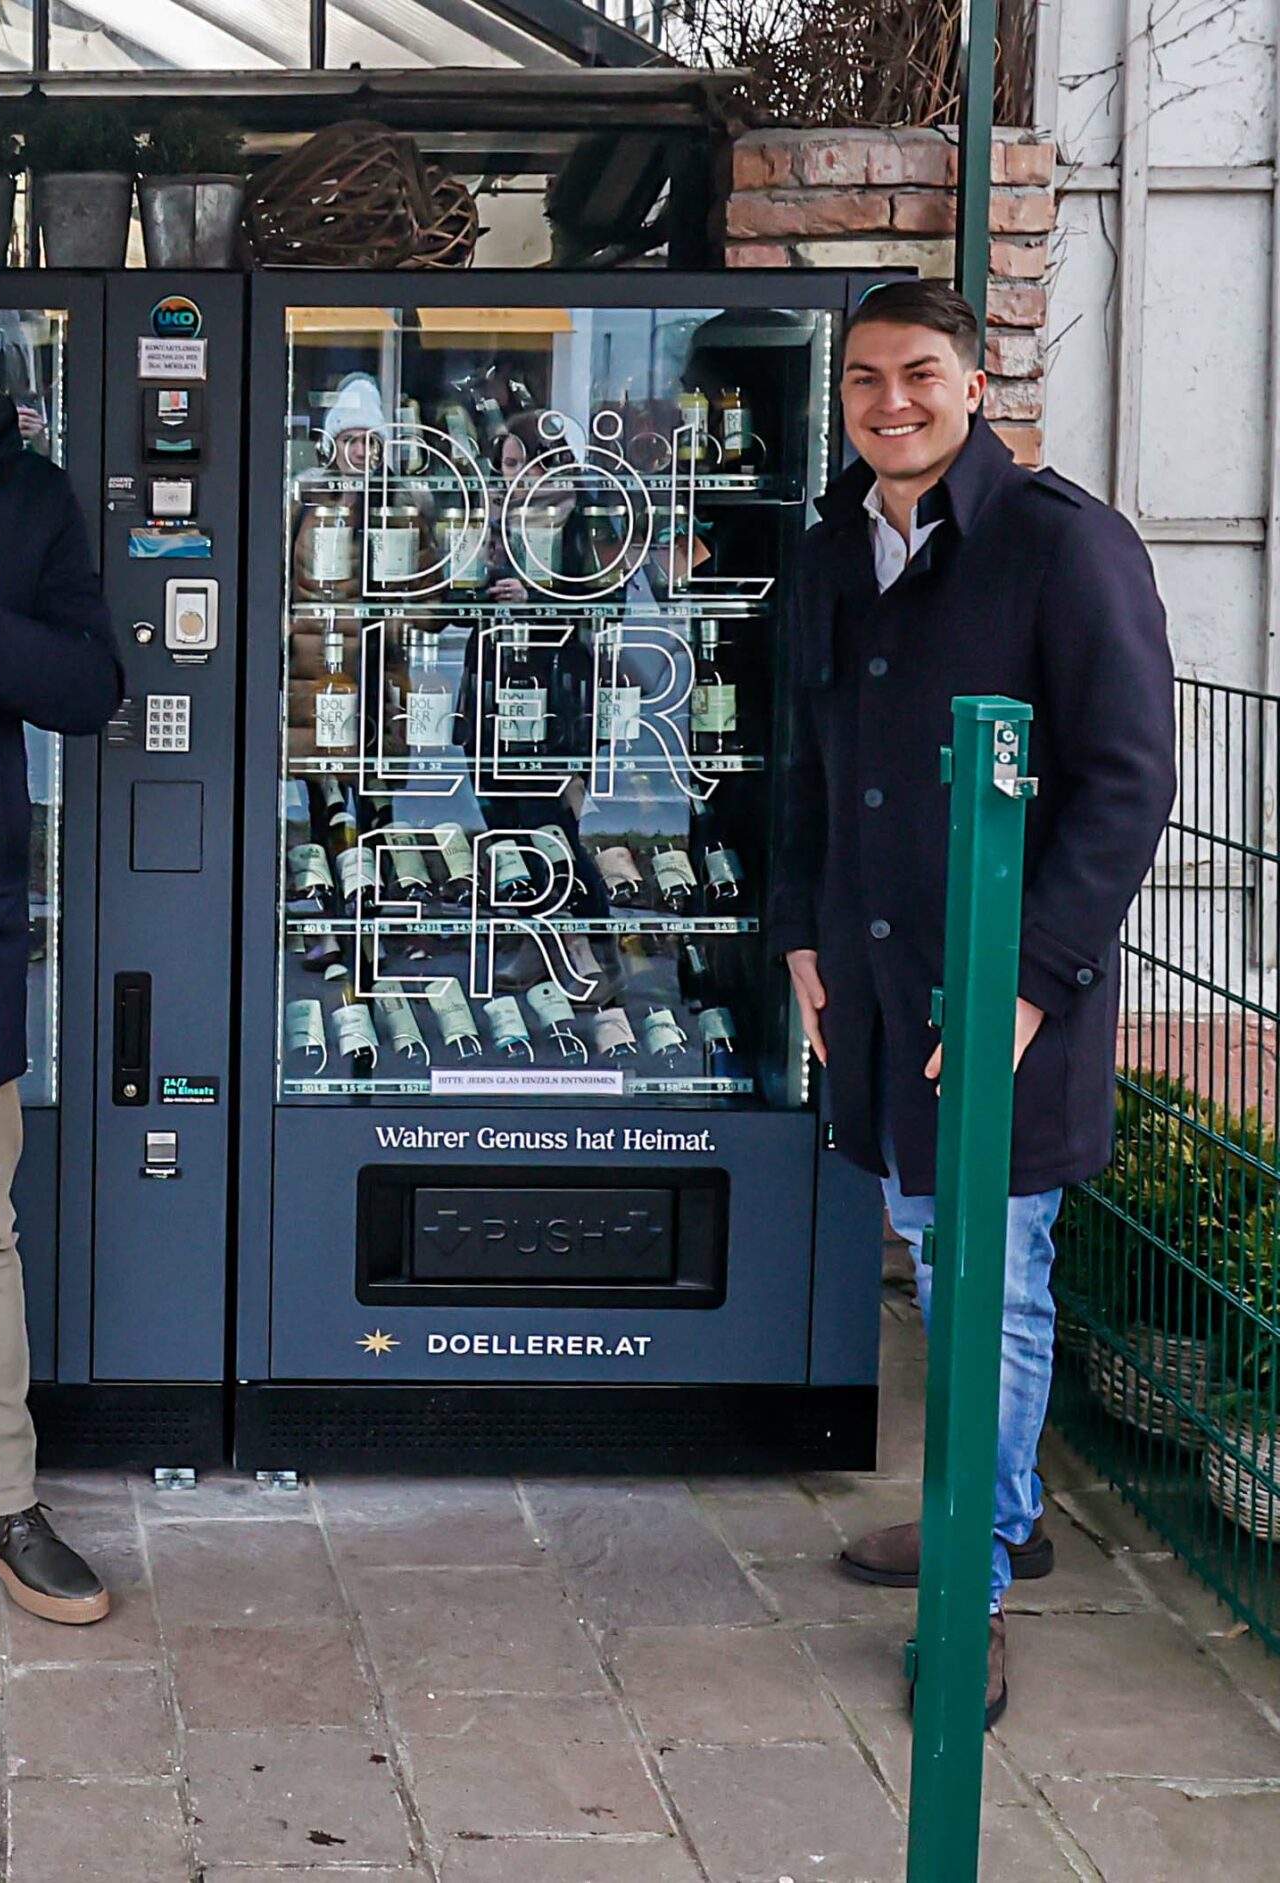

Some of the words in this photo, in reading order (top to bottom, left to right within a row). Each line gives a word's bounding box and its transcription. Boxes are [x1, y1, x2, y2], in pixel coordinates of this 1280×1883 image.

[358, 620, 720, 801] LER
[354, 830, 599, 1002] ER
[376, 1125, 470, 1149] Wahrer
[477, 1127, 568, 1150] Genuss
[576, 1127, 616, 1150] hat
[623, 1128, 716, 1151] Heimat.
[482, 1218, 608, 1253] PUSH
[427, 1334, 653, 1356] DOELLERER.AT
